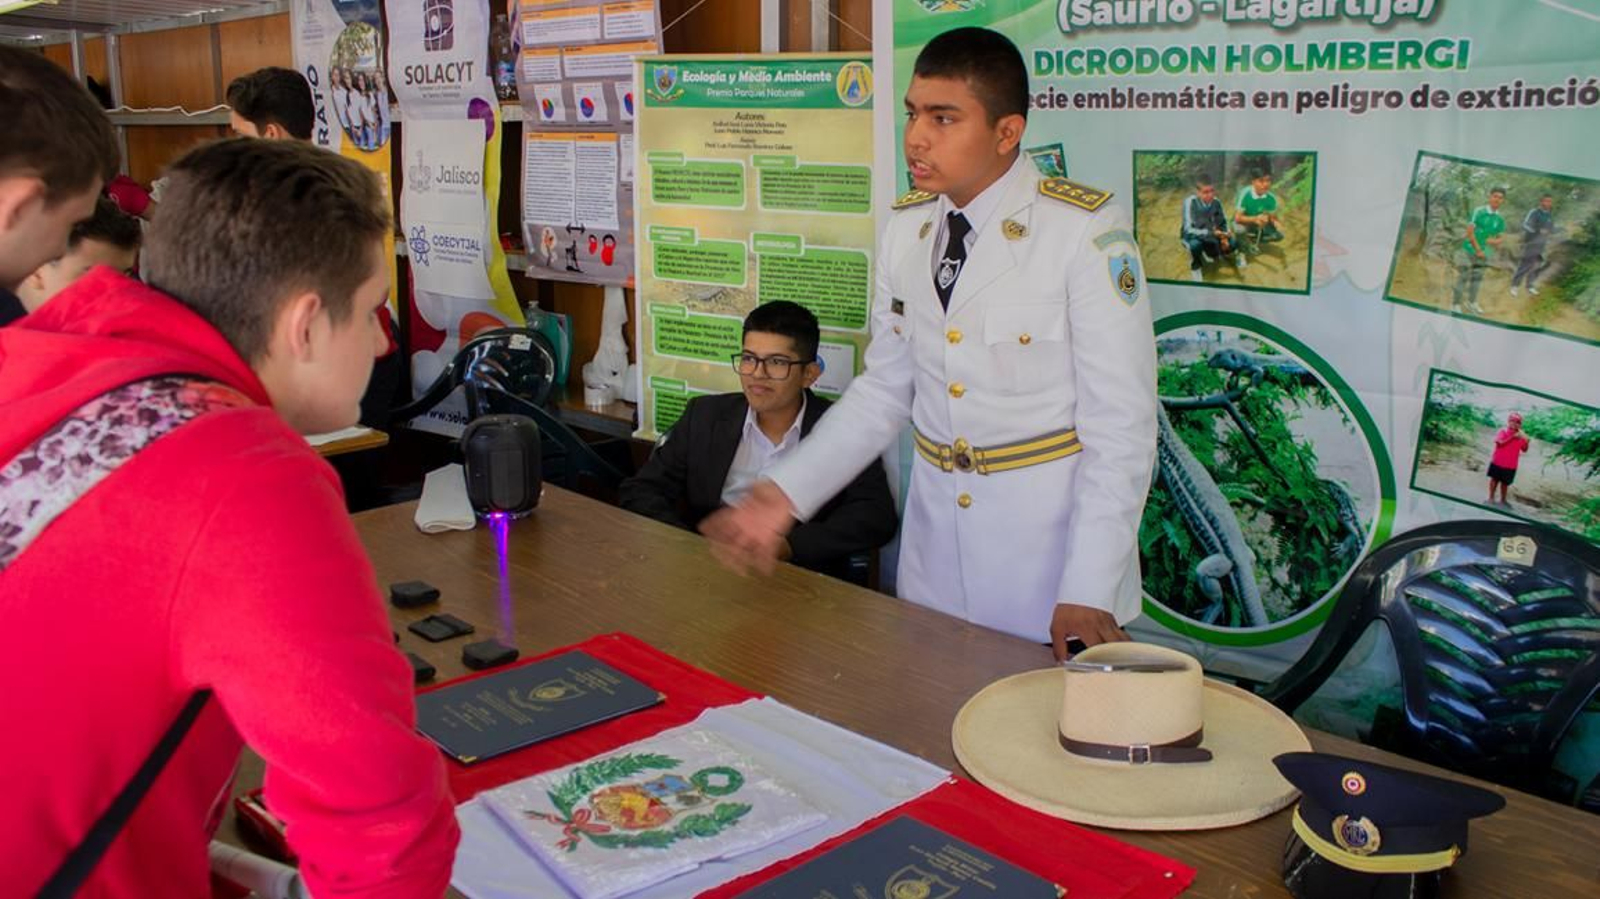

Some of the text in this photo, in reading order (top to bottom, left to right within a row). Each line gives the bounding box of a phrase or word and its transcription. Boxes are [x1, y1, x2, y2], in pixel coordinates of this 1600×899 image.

[1033, 38, 1471, 77] DICRODON HOLMBERGI
[404, 61, 475, 86] SOLACYT
[682, 70, 832, 84] Ecología y Medio Ambiente
[734, 88, 766, 99] Parques
[767, 88, 805, 98] Naturales
[1073, 85, 1247, 109] emblemática
[1252, 91, 1290, 109] en
[1296, 82, 1404, 114] peligro
[1410, 84, 1450, 109] de
[436, 165, 480, 185] Jalisco
[432, 234, 482, 252] COECYTJAL
[1502, 540, 1528, 555] 66
